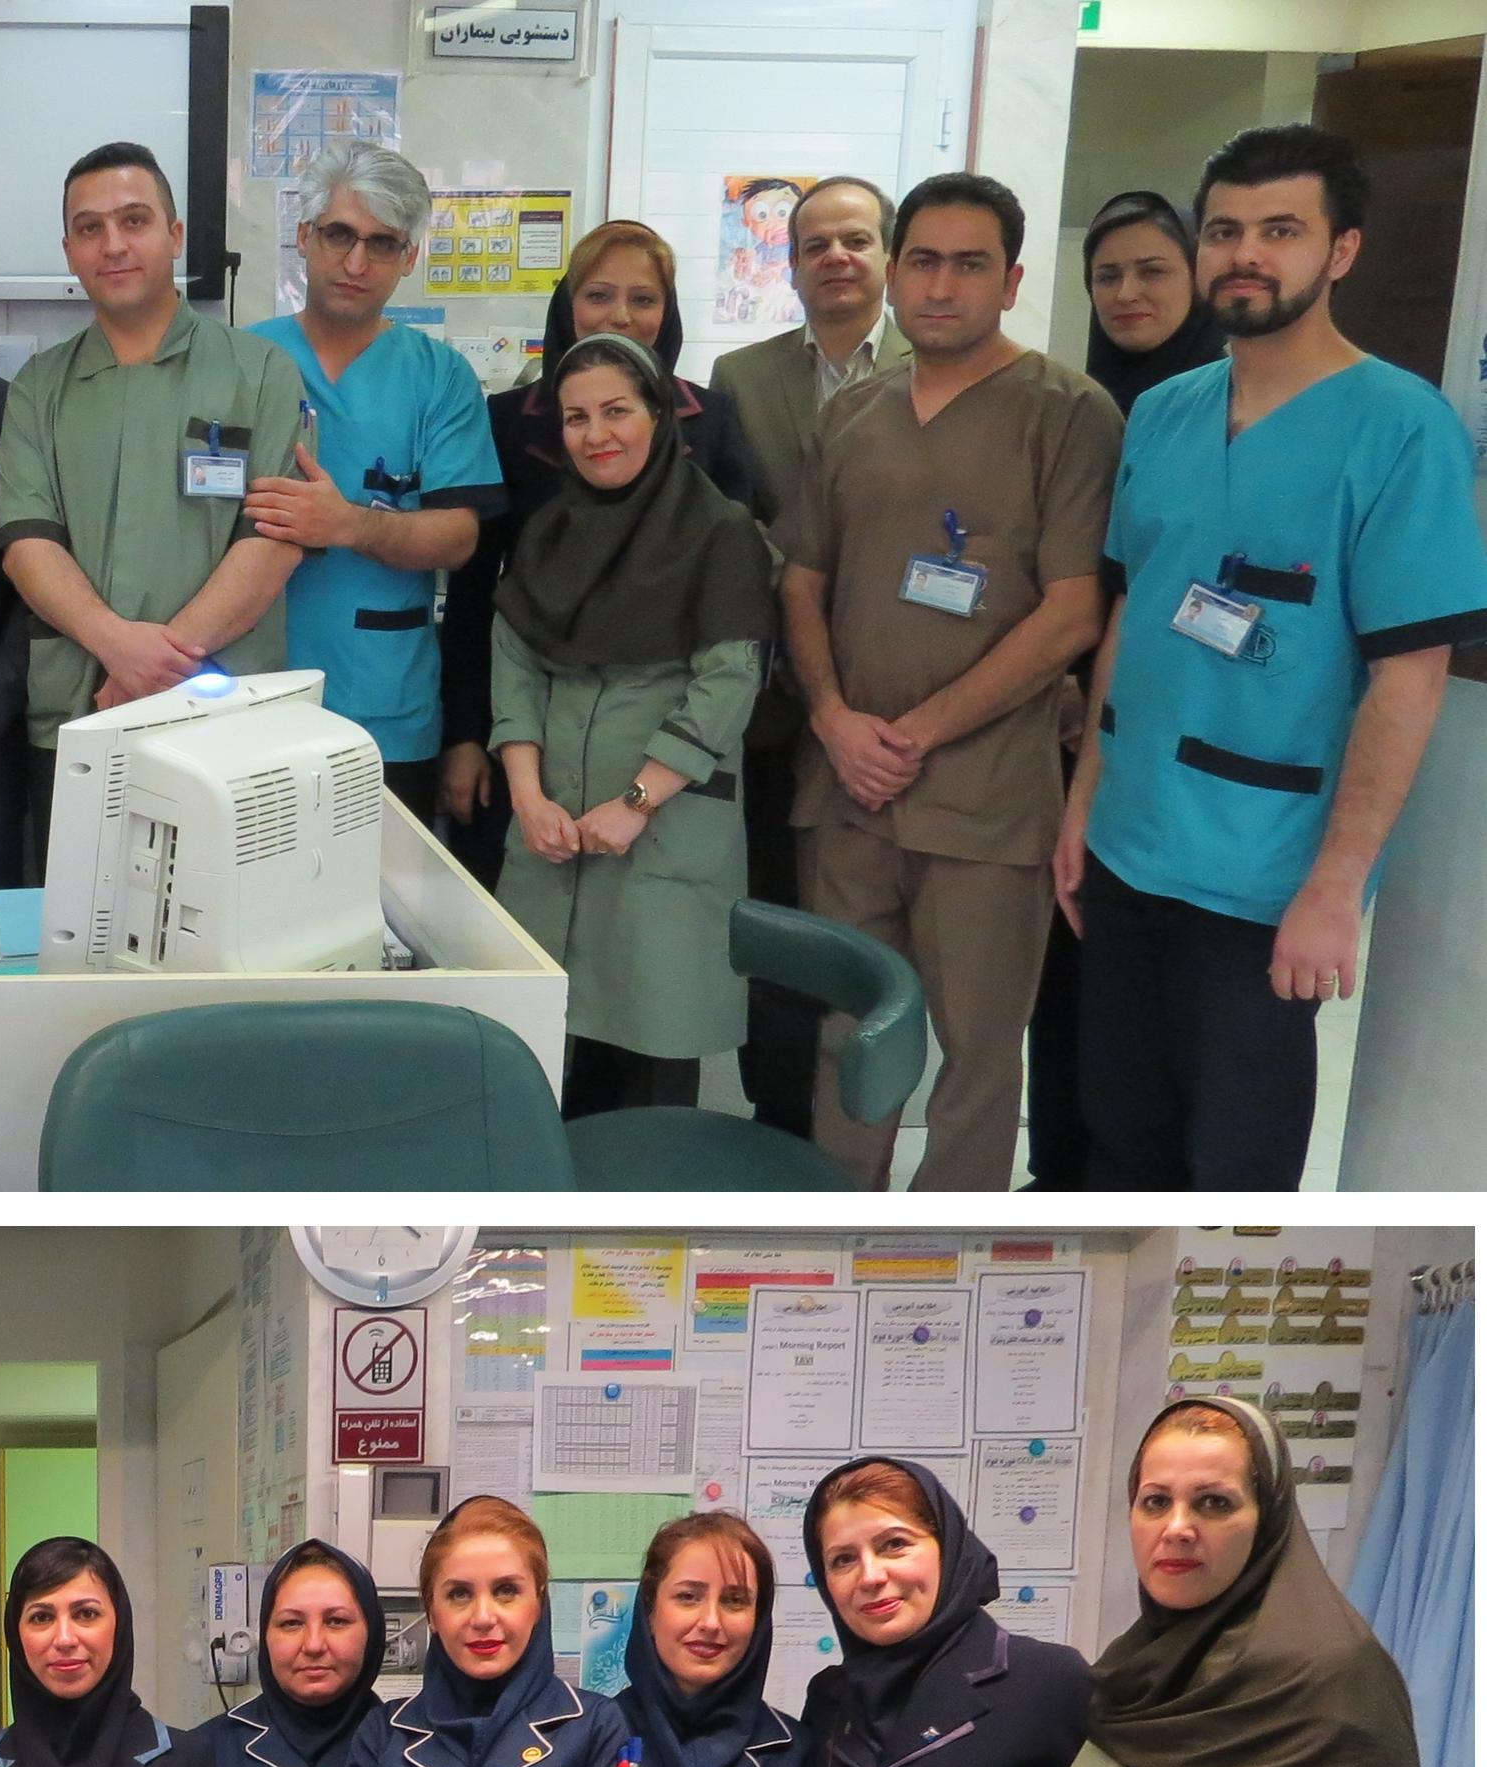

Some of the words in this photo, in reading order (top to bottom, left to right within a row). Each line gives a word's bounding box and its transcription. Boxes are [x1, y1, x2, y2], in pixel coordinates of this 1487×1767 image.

[440, 22, 496, 44] بیماران
[500, 23, 570, 45] دستشویی
[779, 1341, 814, 1351] Morning
[816, 1340, 846, 1350] Report
[341, 1419, 363, 1431] همراه
[363, 1419, 381, 1431] تلفن
[381, 1418, 389, 1430] از
[389, 1419, 417, 1429] استفاده
[357, 1438, 399, 1456] ممنوع
[773, 1479, 808, 1489] Morning
[214, 1568, 223, 1620] DERMAGRIP
